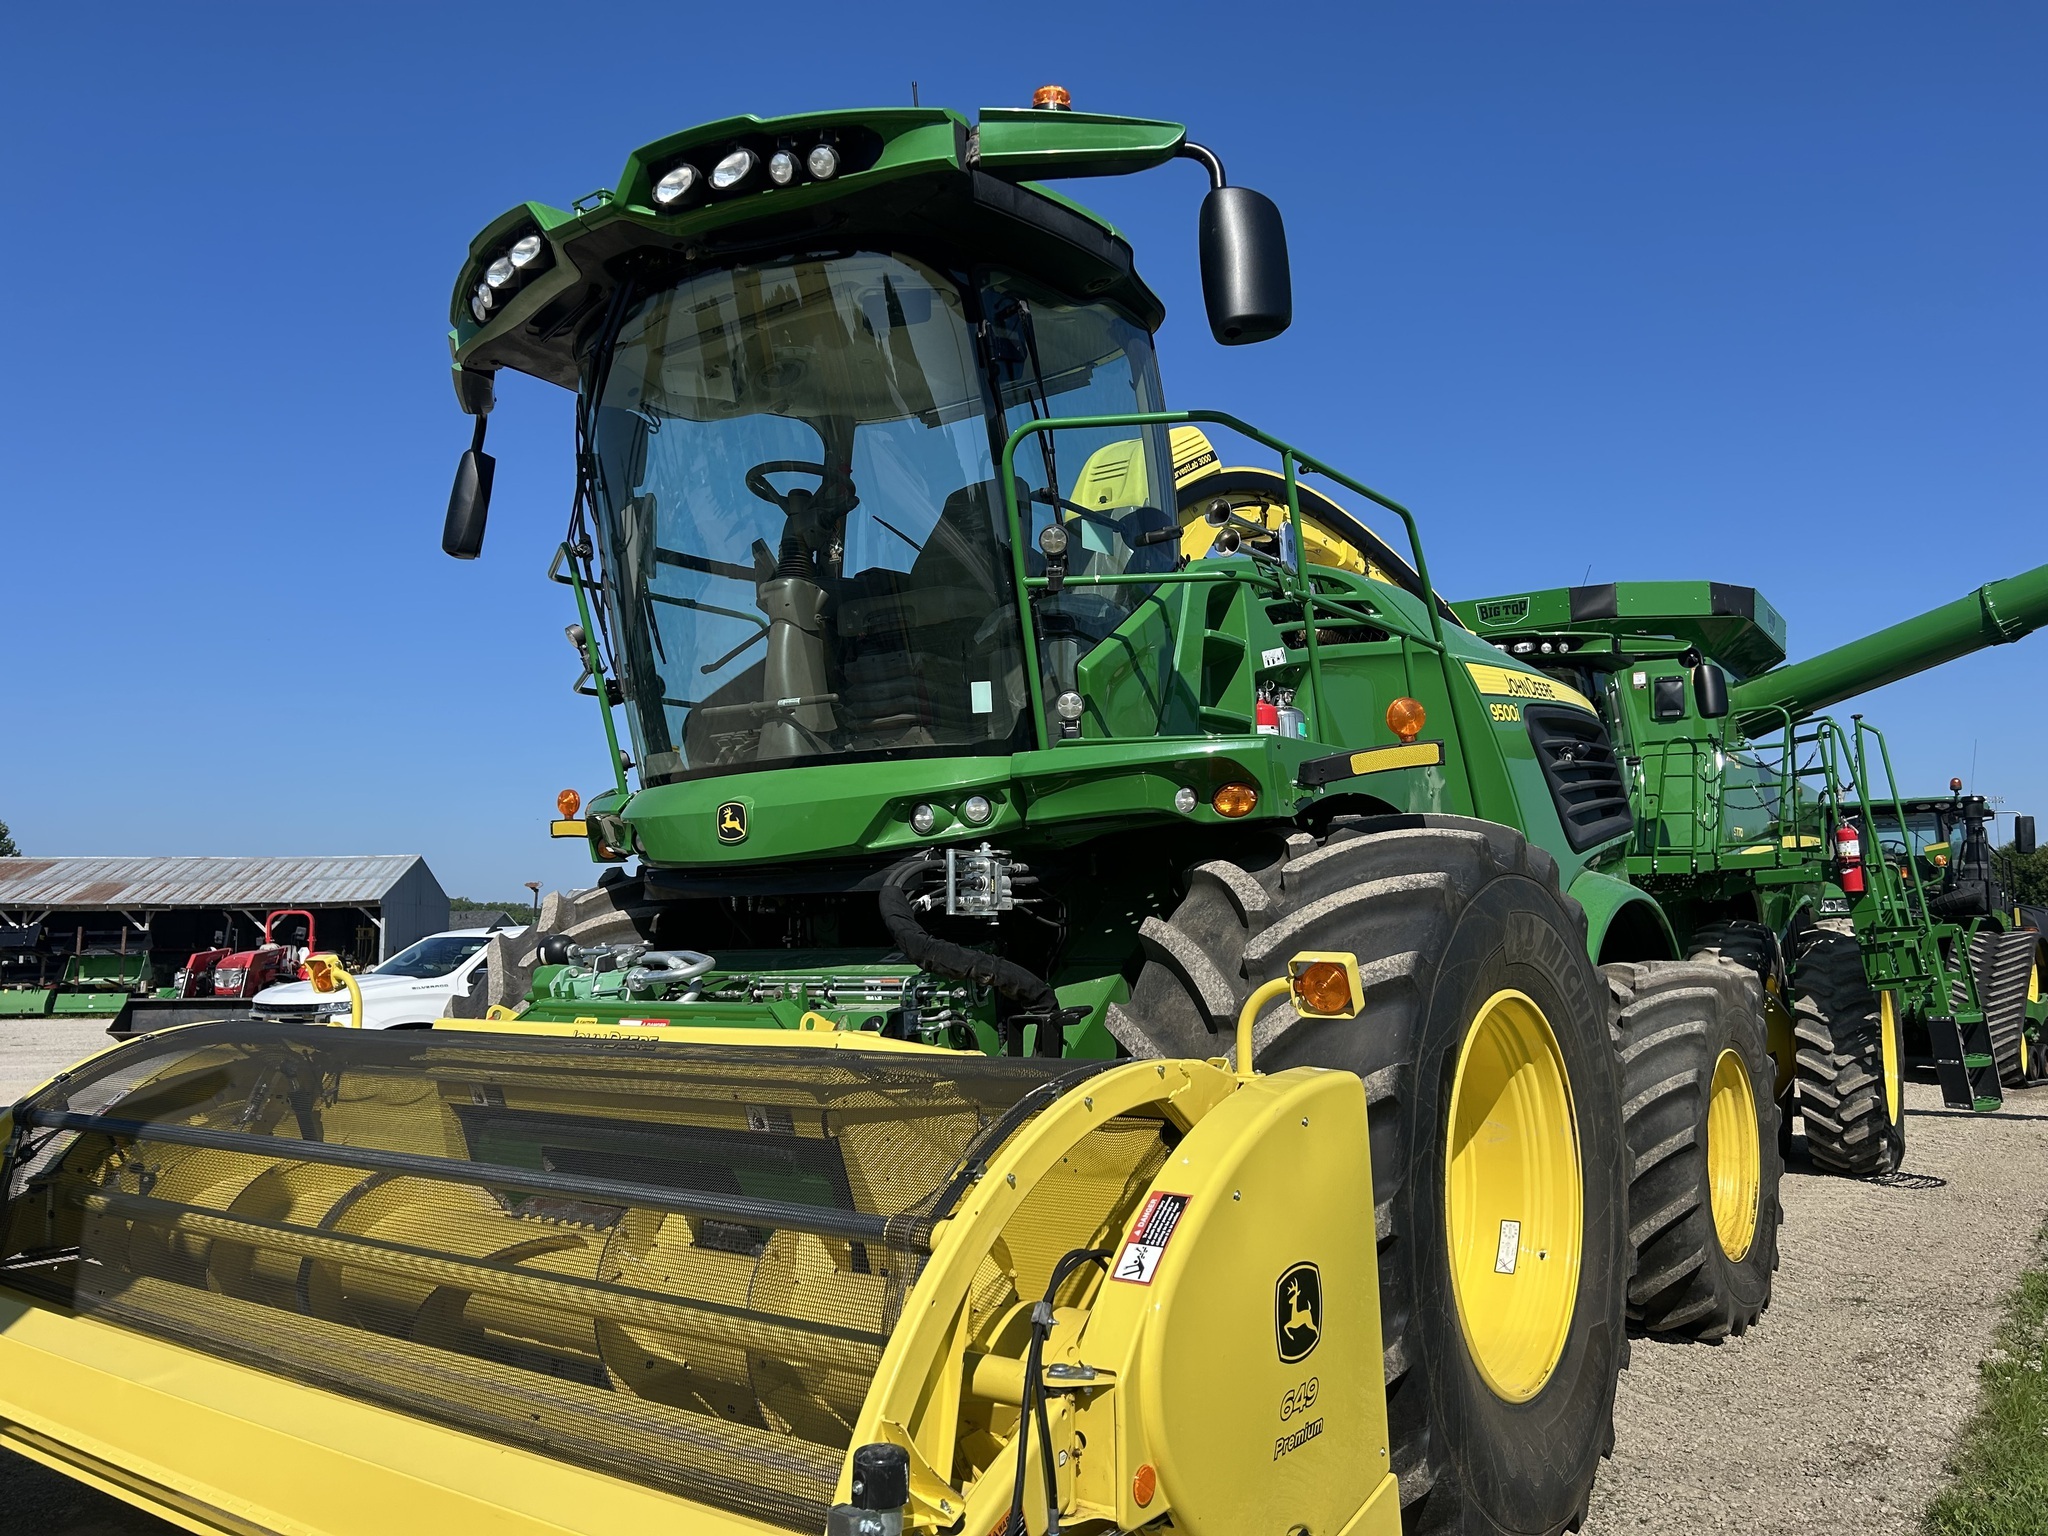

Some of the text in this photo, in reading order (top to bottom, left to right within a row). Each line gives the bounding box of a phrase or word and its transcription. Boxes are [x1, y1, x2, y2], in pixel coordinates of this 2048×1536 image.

[1198, 453, 1212, 466] 3000
[1479, 605, 1501, 621] BIG
[1502, 600, 1527, 615] TOP
[1503, 674, 1556, 699] JOHN DEERE
[1489, 702, 1521, 722] 9500i
[1138, 1199, 1158, 1228] DANGER
[1279, 1376, 1320, 1422] 649
[1273, 1417, 1324, 1462] Premium
